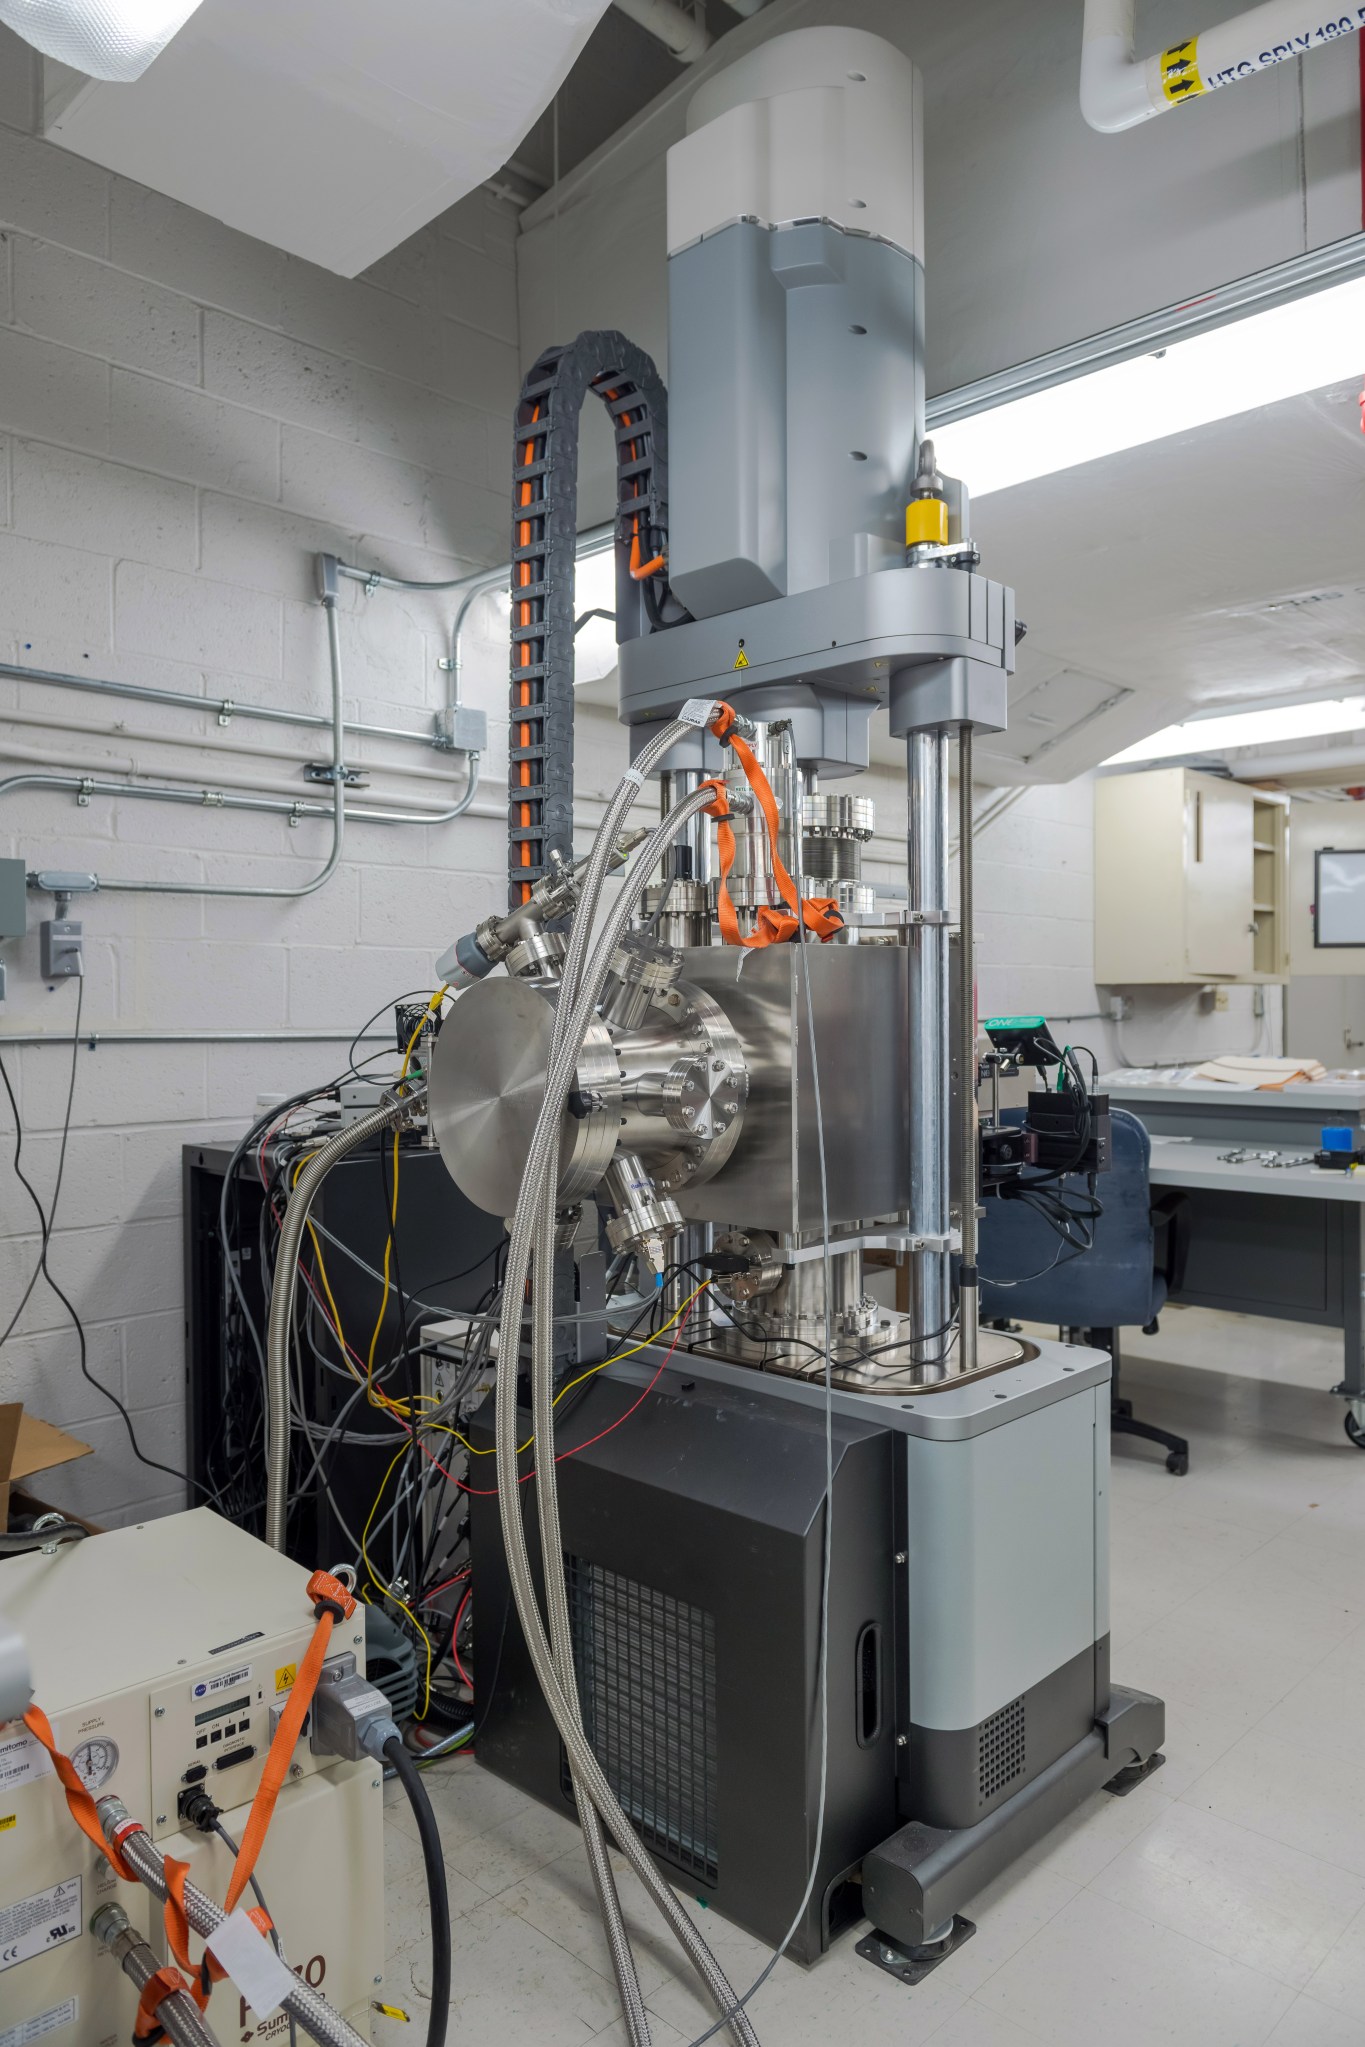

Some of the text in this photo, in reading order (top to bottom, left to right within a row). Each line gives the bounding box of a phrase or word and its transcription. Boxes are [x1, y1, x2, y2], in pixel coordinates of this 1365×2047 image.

[1207, 61, 1256, 88] HTG
[1258, 32, 1310, 66] SPLY
[196, 1722, 220, 1736] OFF ON
